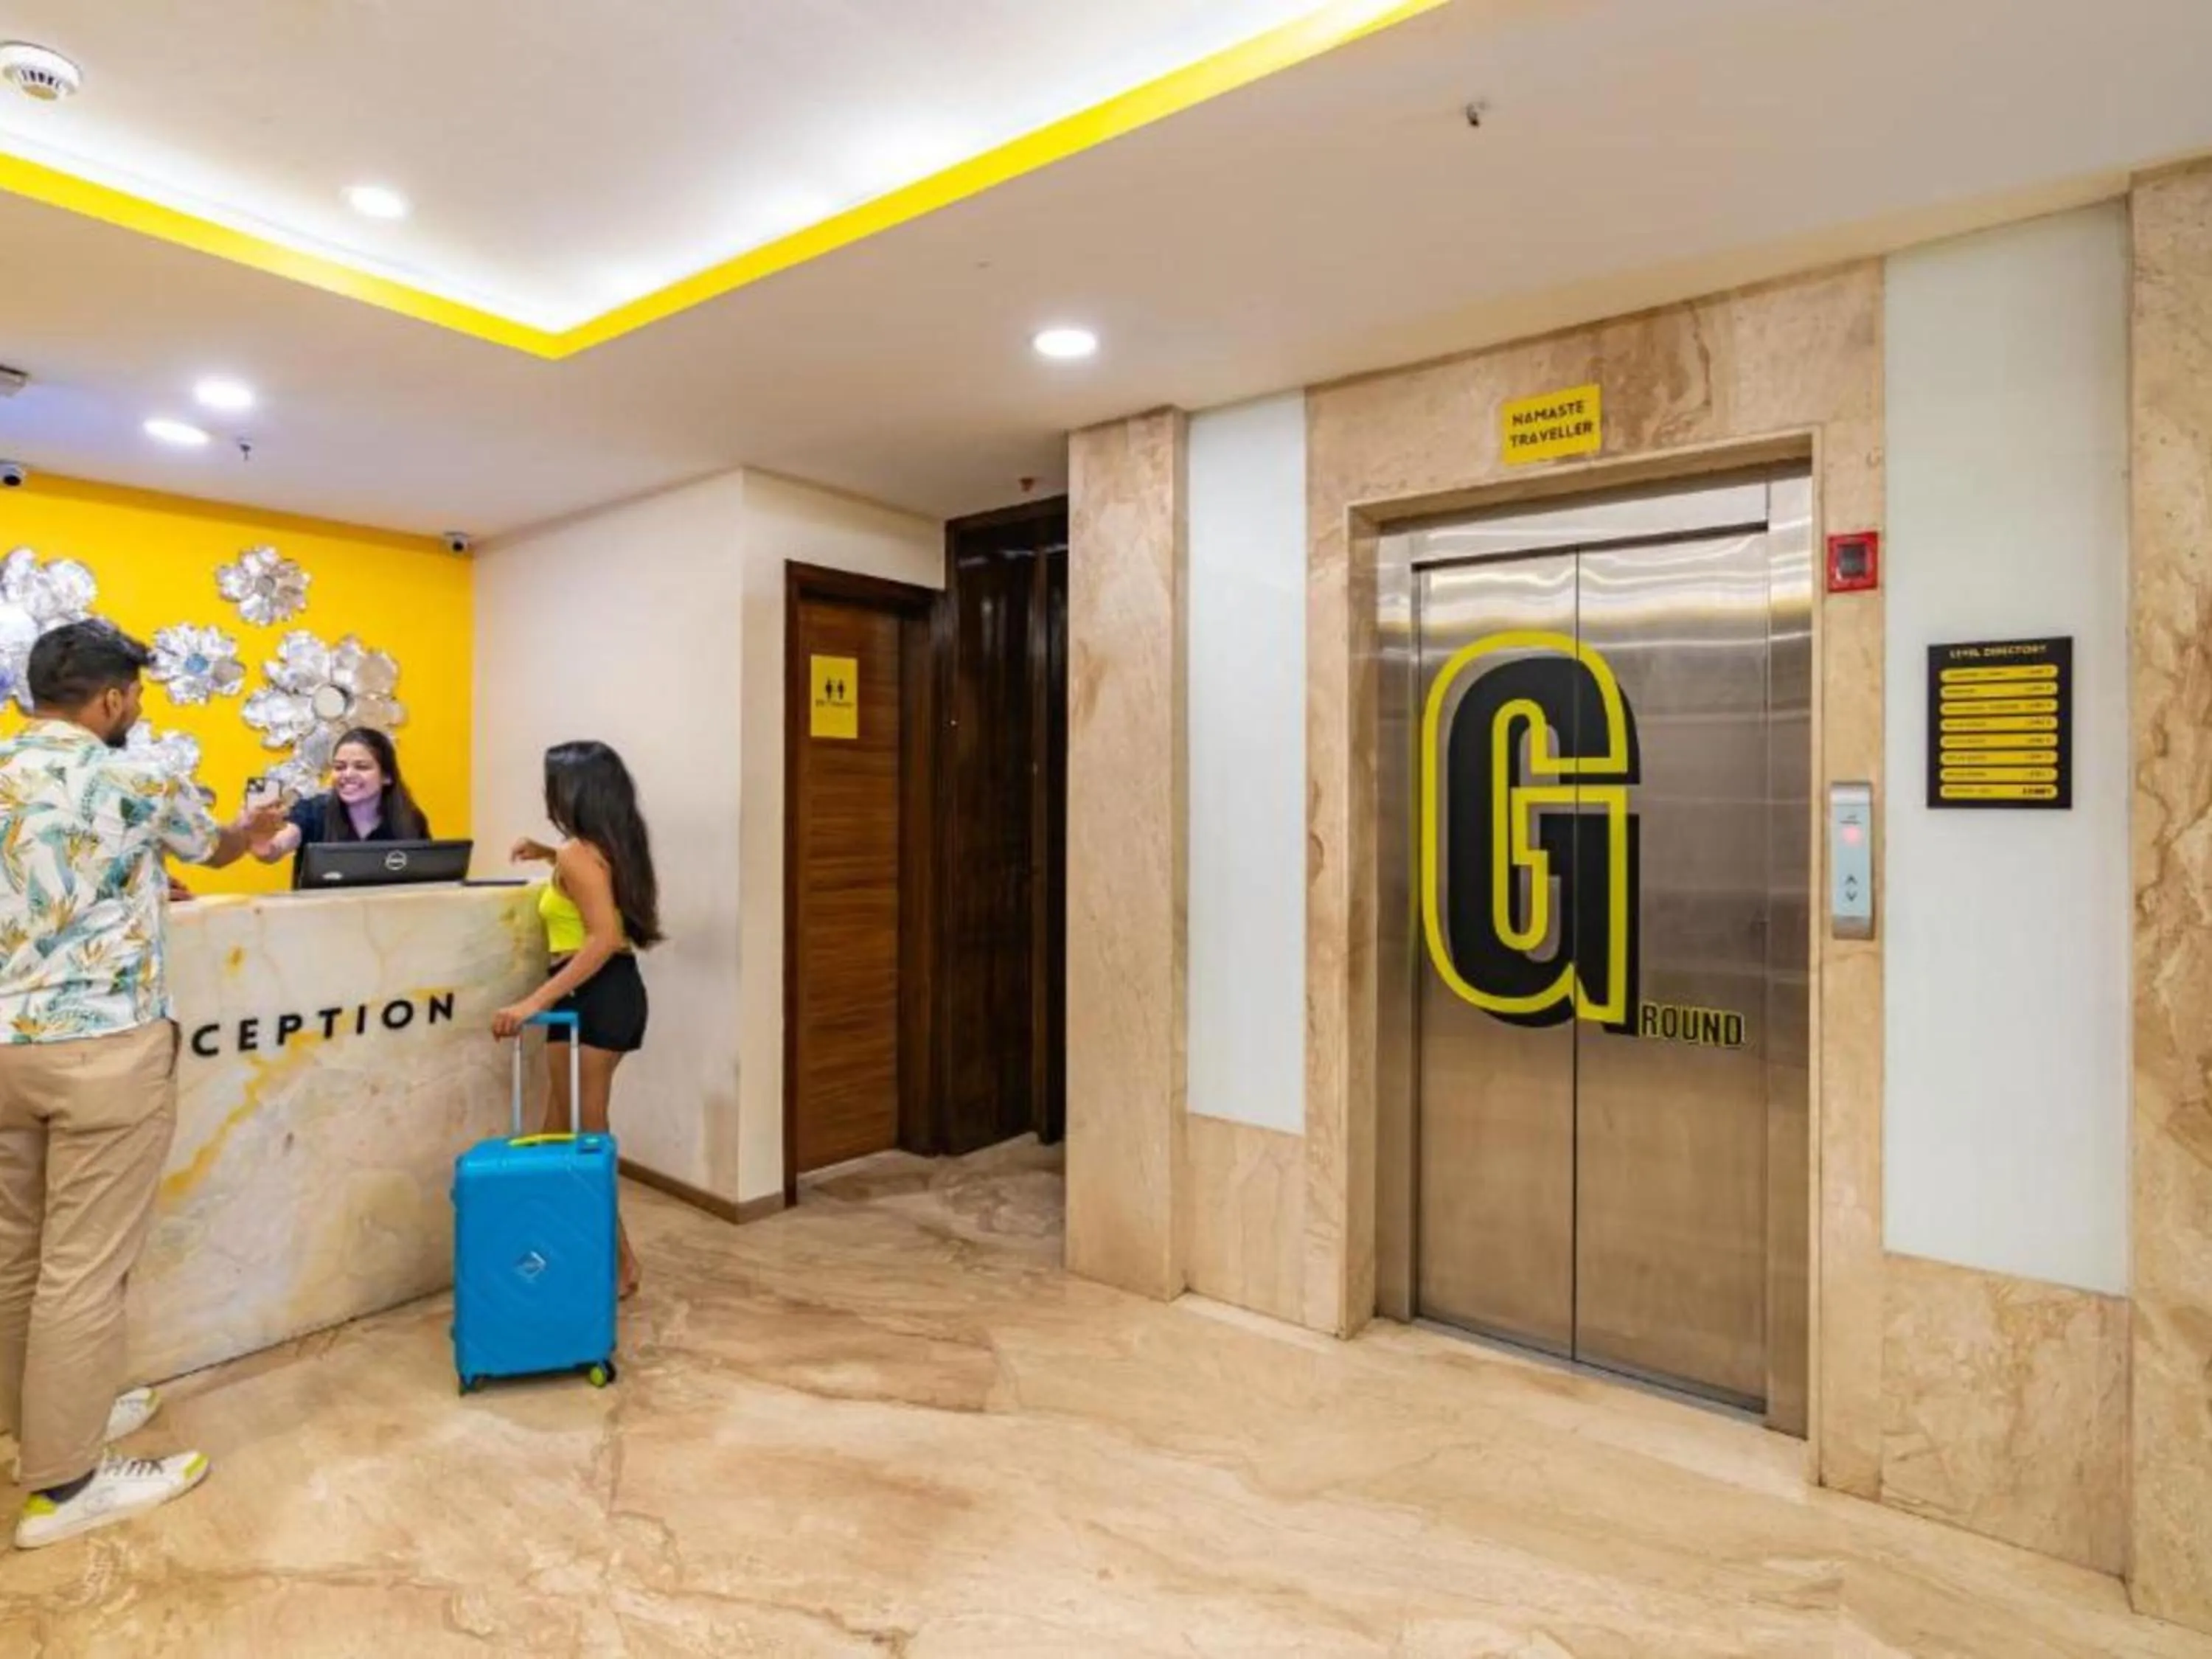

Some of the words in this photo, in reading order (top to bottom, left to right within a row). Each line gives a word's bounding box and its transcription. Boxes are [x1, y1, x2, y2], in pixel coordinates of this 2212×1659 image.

[1512, 400, 1585, 426] NAMASTE
[1509, 420, 1593, 448] TRAVELLER
[191, 992, 454, 1057] CEPTION
